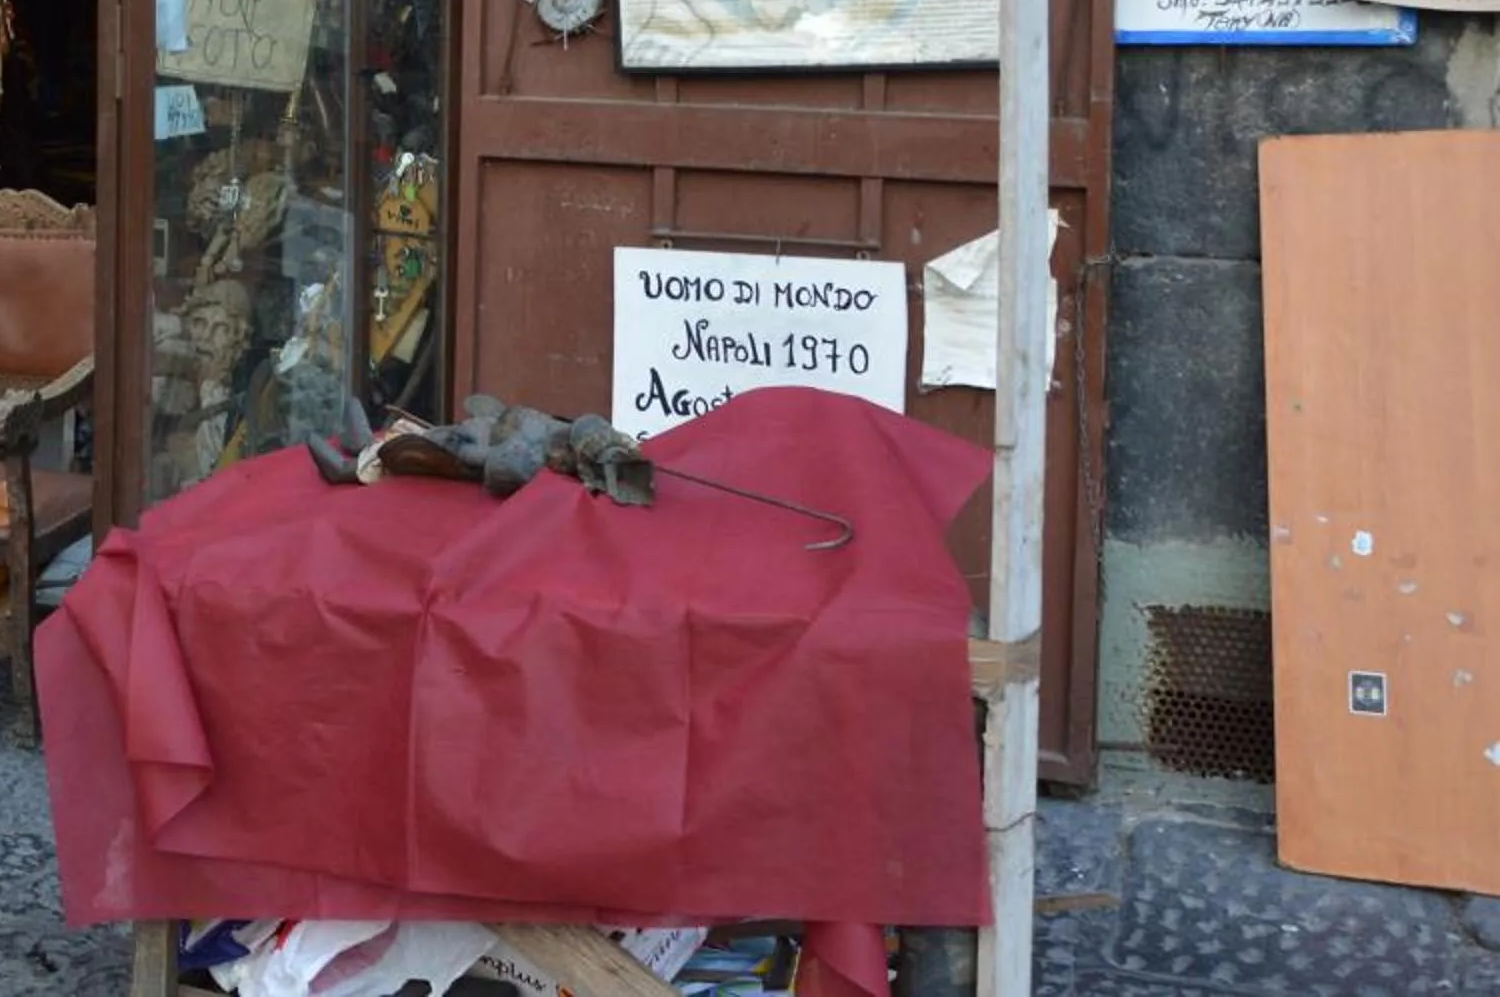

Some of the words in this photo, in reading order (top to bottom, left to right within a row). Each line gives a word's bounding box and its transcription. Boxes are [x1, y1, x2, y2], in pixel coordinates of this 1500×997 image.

[639, 271, 725, 301] UOMO
[732, 280, 761, 306] DI
[774, 282, 879, 311] MONDO
[782, 333, 870, 374] 1970
